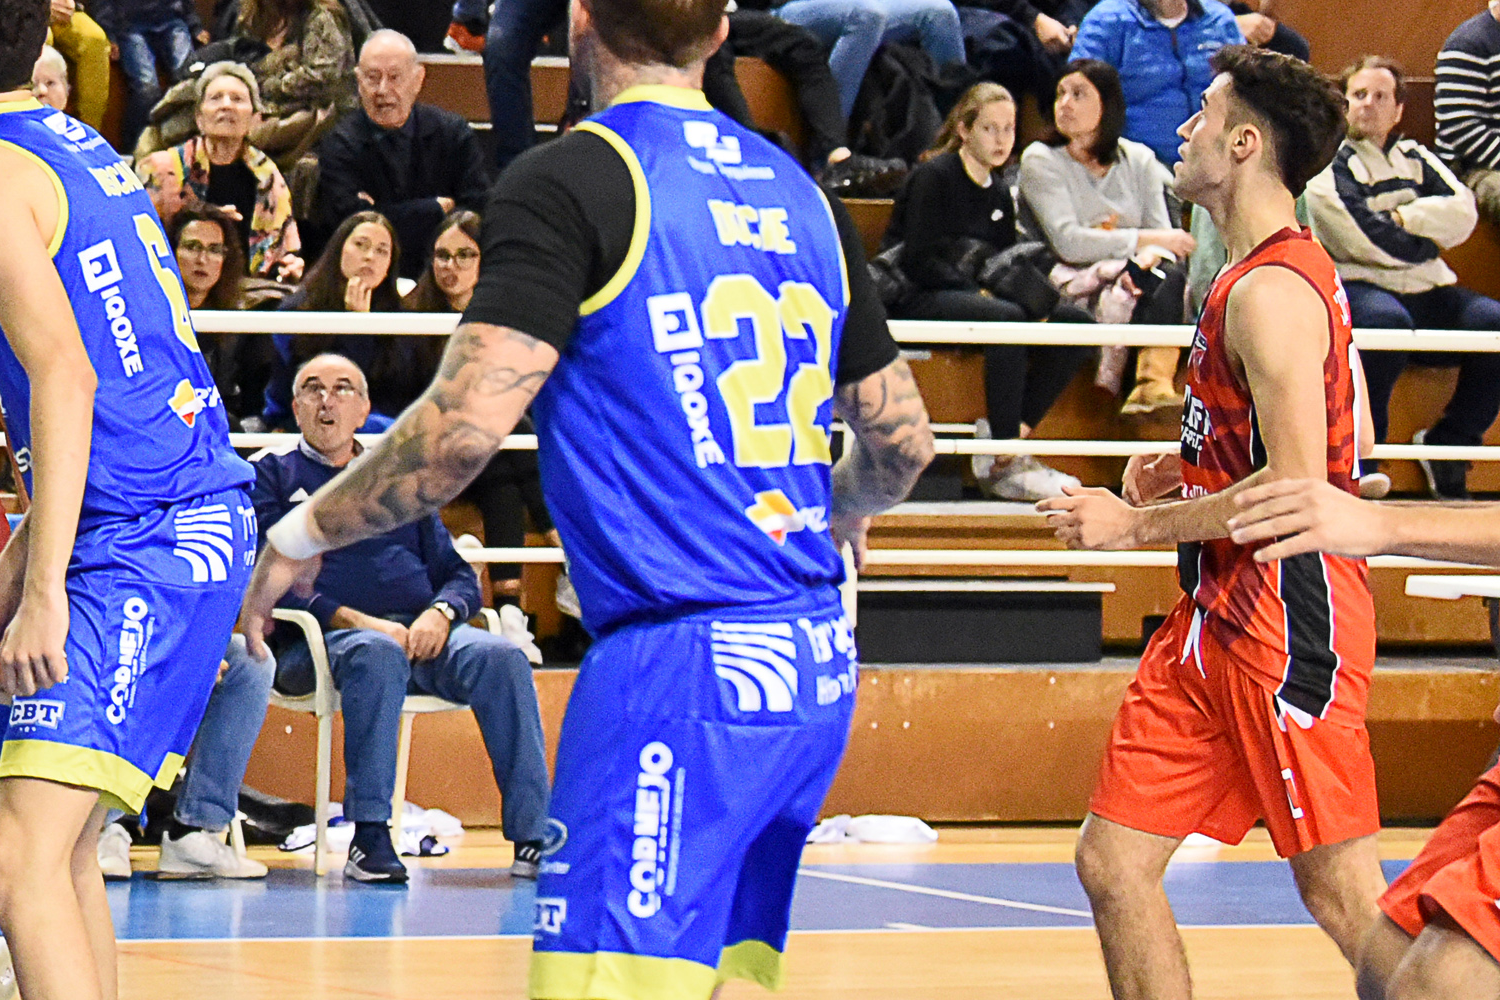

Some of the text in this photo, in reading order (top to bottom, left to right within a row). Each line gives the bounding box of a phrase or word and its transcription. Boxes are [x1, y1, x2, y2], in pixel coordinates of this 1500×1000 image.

[100, 285, 145, 378] IQOXE
[700, 272, 839, 469] 22
[669, 350, 726, 469] IQOXE
[9, 699, 66, 730] CBT
